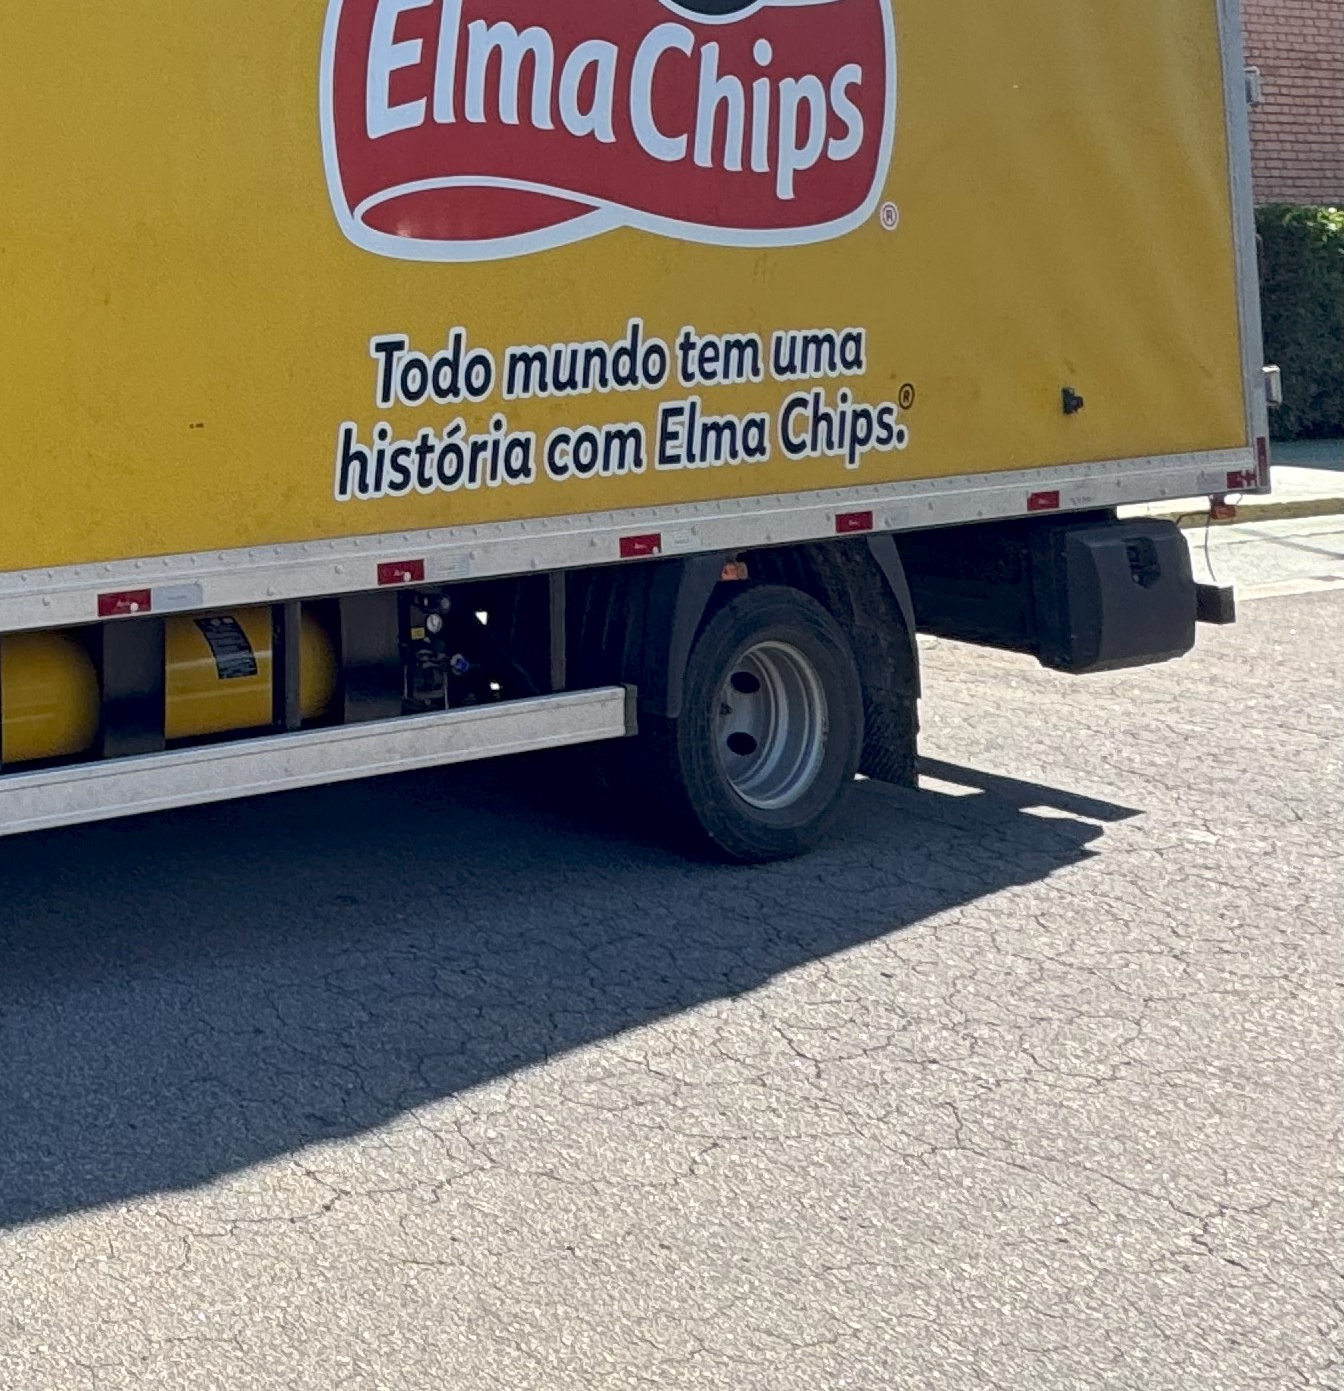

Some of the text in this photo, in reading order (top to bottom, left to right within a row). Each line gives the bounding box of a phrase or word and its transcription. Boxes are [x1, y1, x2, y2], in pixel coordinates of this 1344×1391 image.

[630, 22, 864, 200] Chips
[374, 323, 863, 403] Todo mundo tem uma
[338, 418, 532, 495] história
[547, 427, 643, 477] com
[658, 401, 766, 466] Elma
